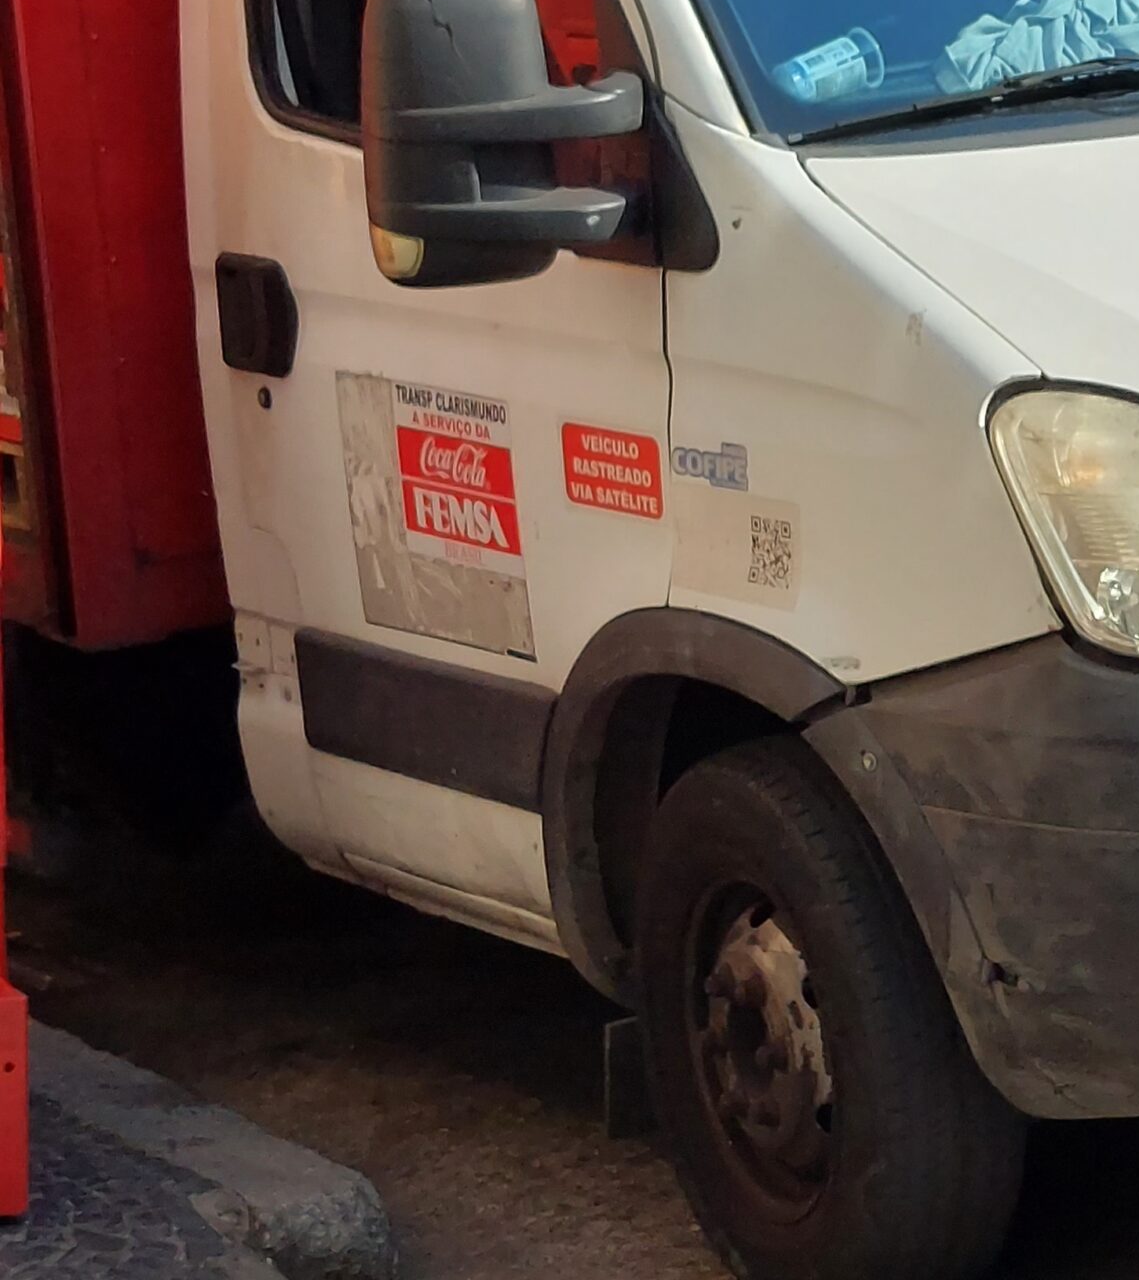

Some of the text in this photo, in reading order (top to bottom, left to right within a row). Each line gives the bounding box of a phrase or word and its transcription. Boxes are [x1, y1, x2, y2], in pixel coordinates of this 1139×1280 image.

[395, 384, 506, 424] TRANSP CLARISMUNDO
[413, 410, 491, 440] A SERVIÇO DA
[573, 456, 652, 488] RASTREADO
[571, 481, 659, 515] VIA SATÉLITE
[413, 486, 509, 548] FEMSA
